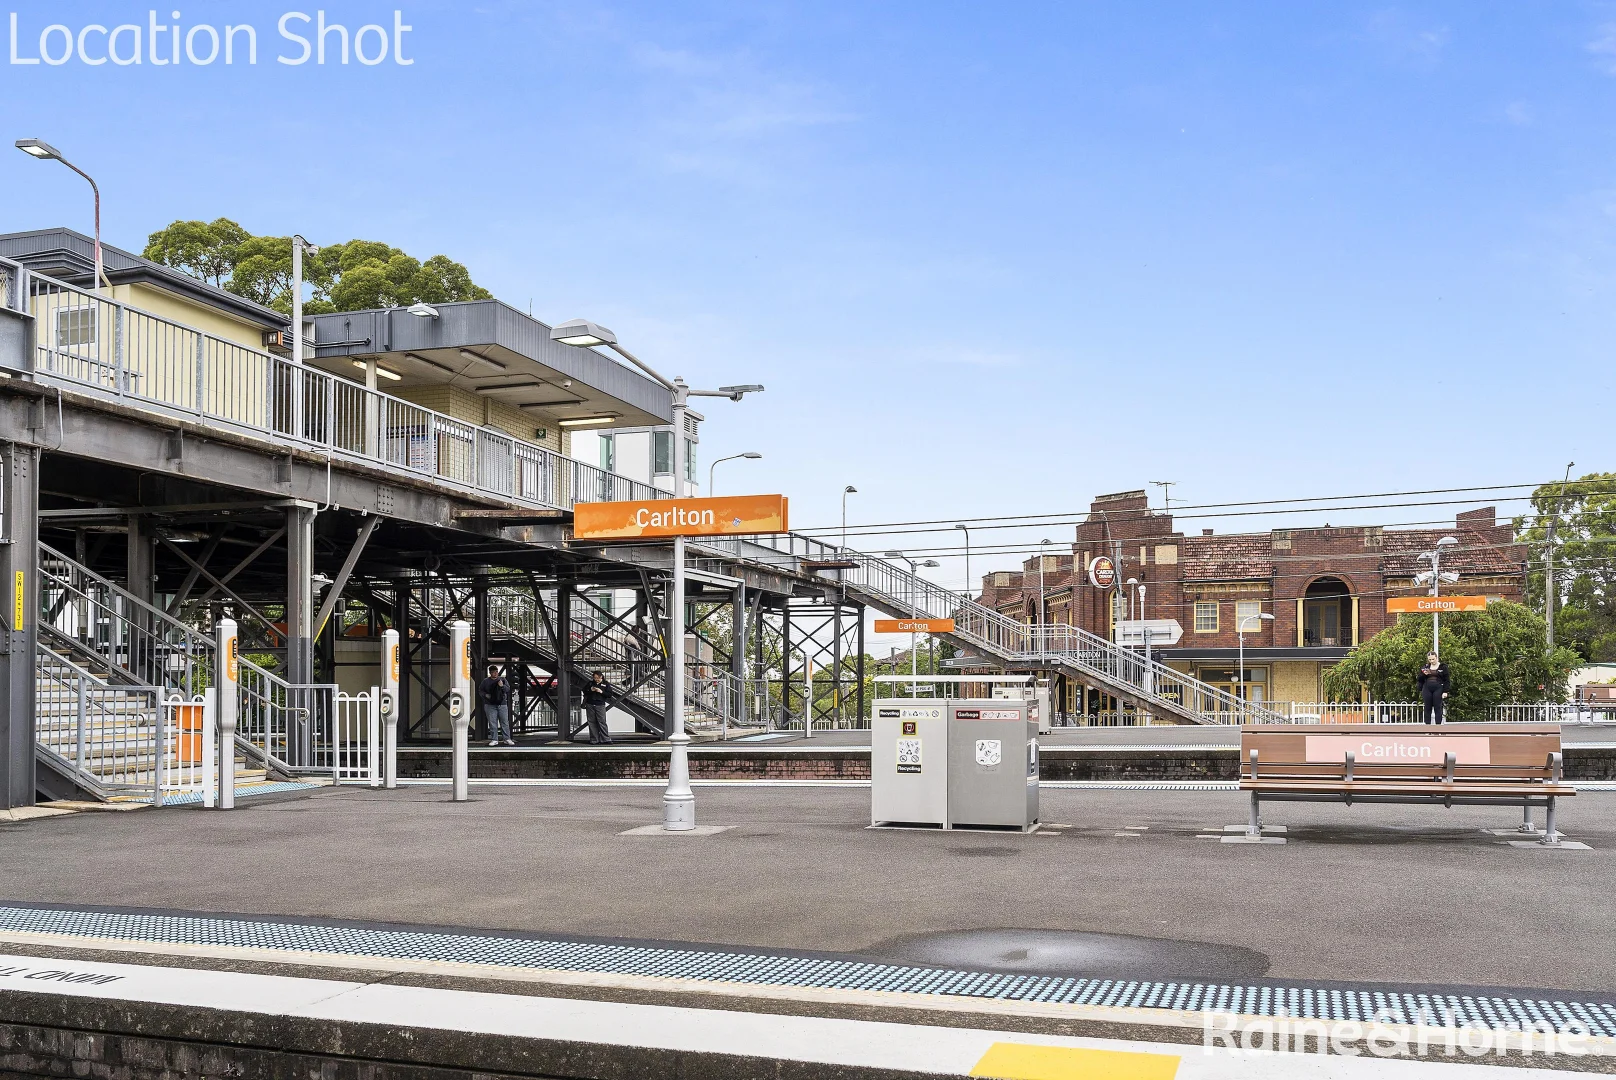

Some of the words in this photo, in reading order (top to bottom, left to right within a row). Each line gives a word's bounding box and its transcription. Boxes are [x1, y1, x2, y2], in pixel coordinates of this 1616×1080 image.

[636, 506, 714, 528] Carlton
[1417, 600, 1456, 609] Carlton
[1360, 741, 1432, 759] Carlton
[897, 765, 922, 773] Recycling
